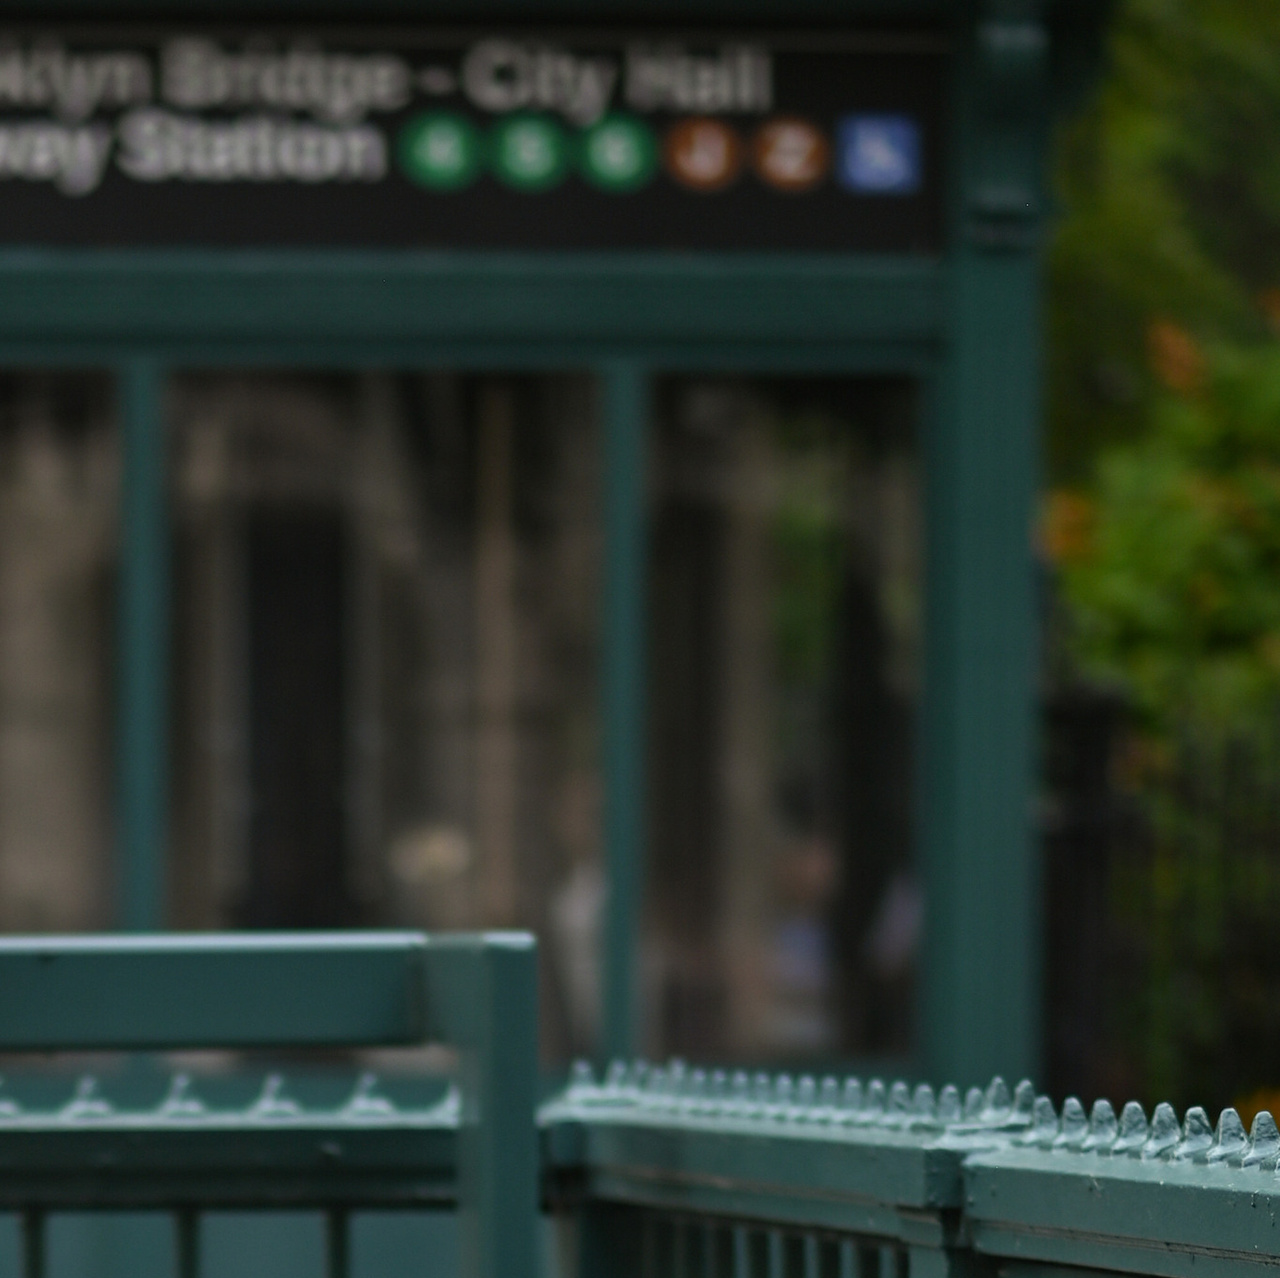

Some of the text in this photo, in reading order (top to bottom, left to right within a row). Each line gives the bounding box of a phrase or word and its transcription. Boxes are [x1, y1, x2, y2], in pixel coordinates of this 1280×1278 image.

[160, 37, 411, 122] Bridge
[463, 38, 617, 125] City
[623, 44, 772, 112] Hall
[120, 108, 387, 182] Station
